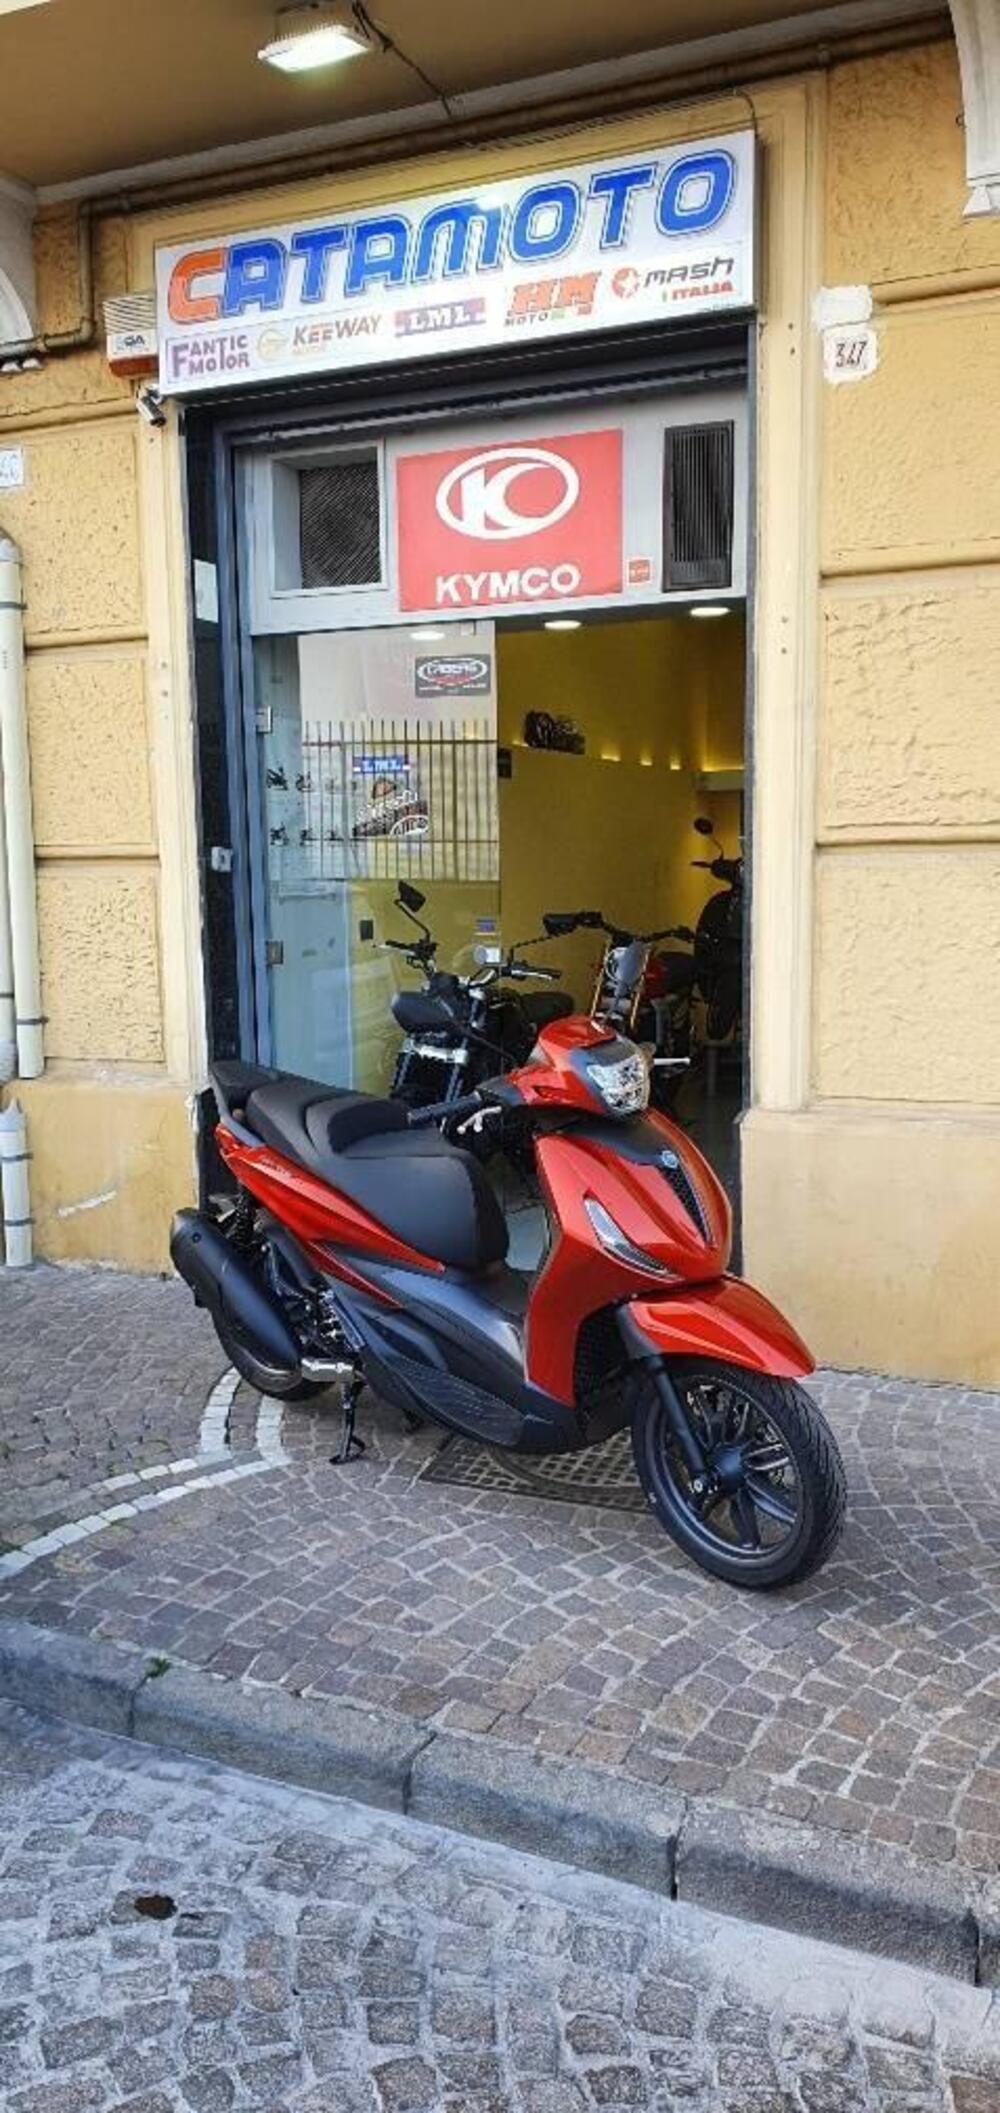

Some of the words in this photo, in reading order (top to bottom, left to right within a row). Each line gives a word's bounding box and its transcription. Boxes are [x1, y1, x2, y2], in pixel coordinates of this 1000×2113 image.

[167, 149, 737, 325] CATAMOTO
[671, 281, 734, 300] ITALIA
[293, 314, 382, 346] KEEWAY
[408, 305, 470, 330] LML
[504, 311, 548, 327] MOTO
[172, 335, 249, 378] FANTIC
[189, 352, 250, 376] MOTOR
[835, 340, 868, 368] 347
[435, 562, 582, 604] KYMCO
